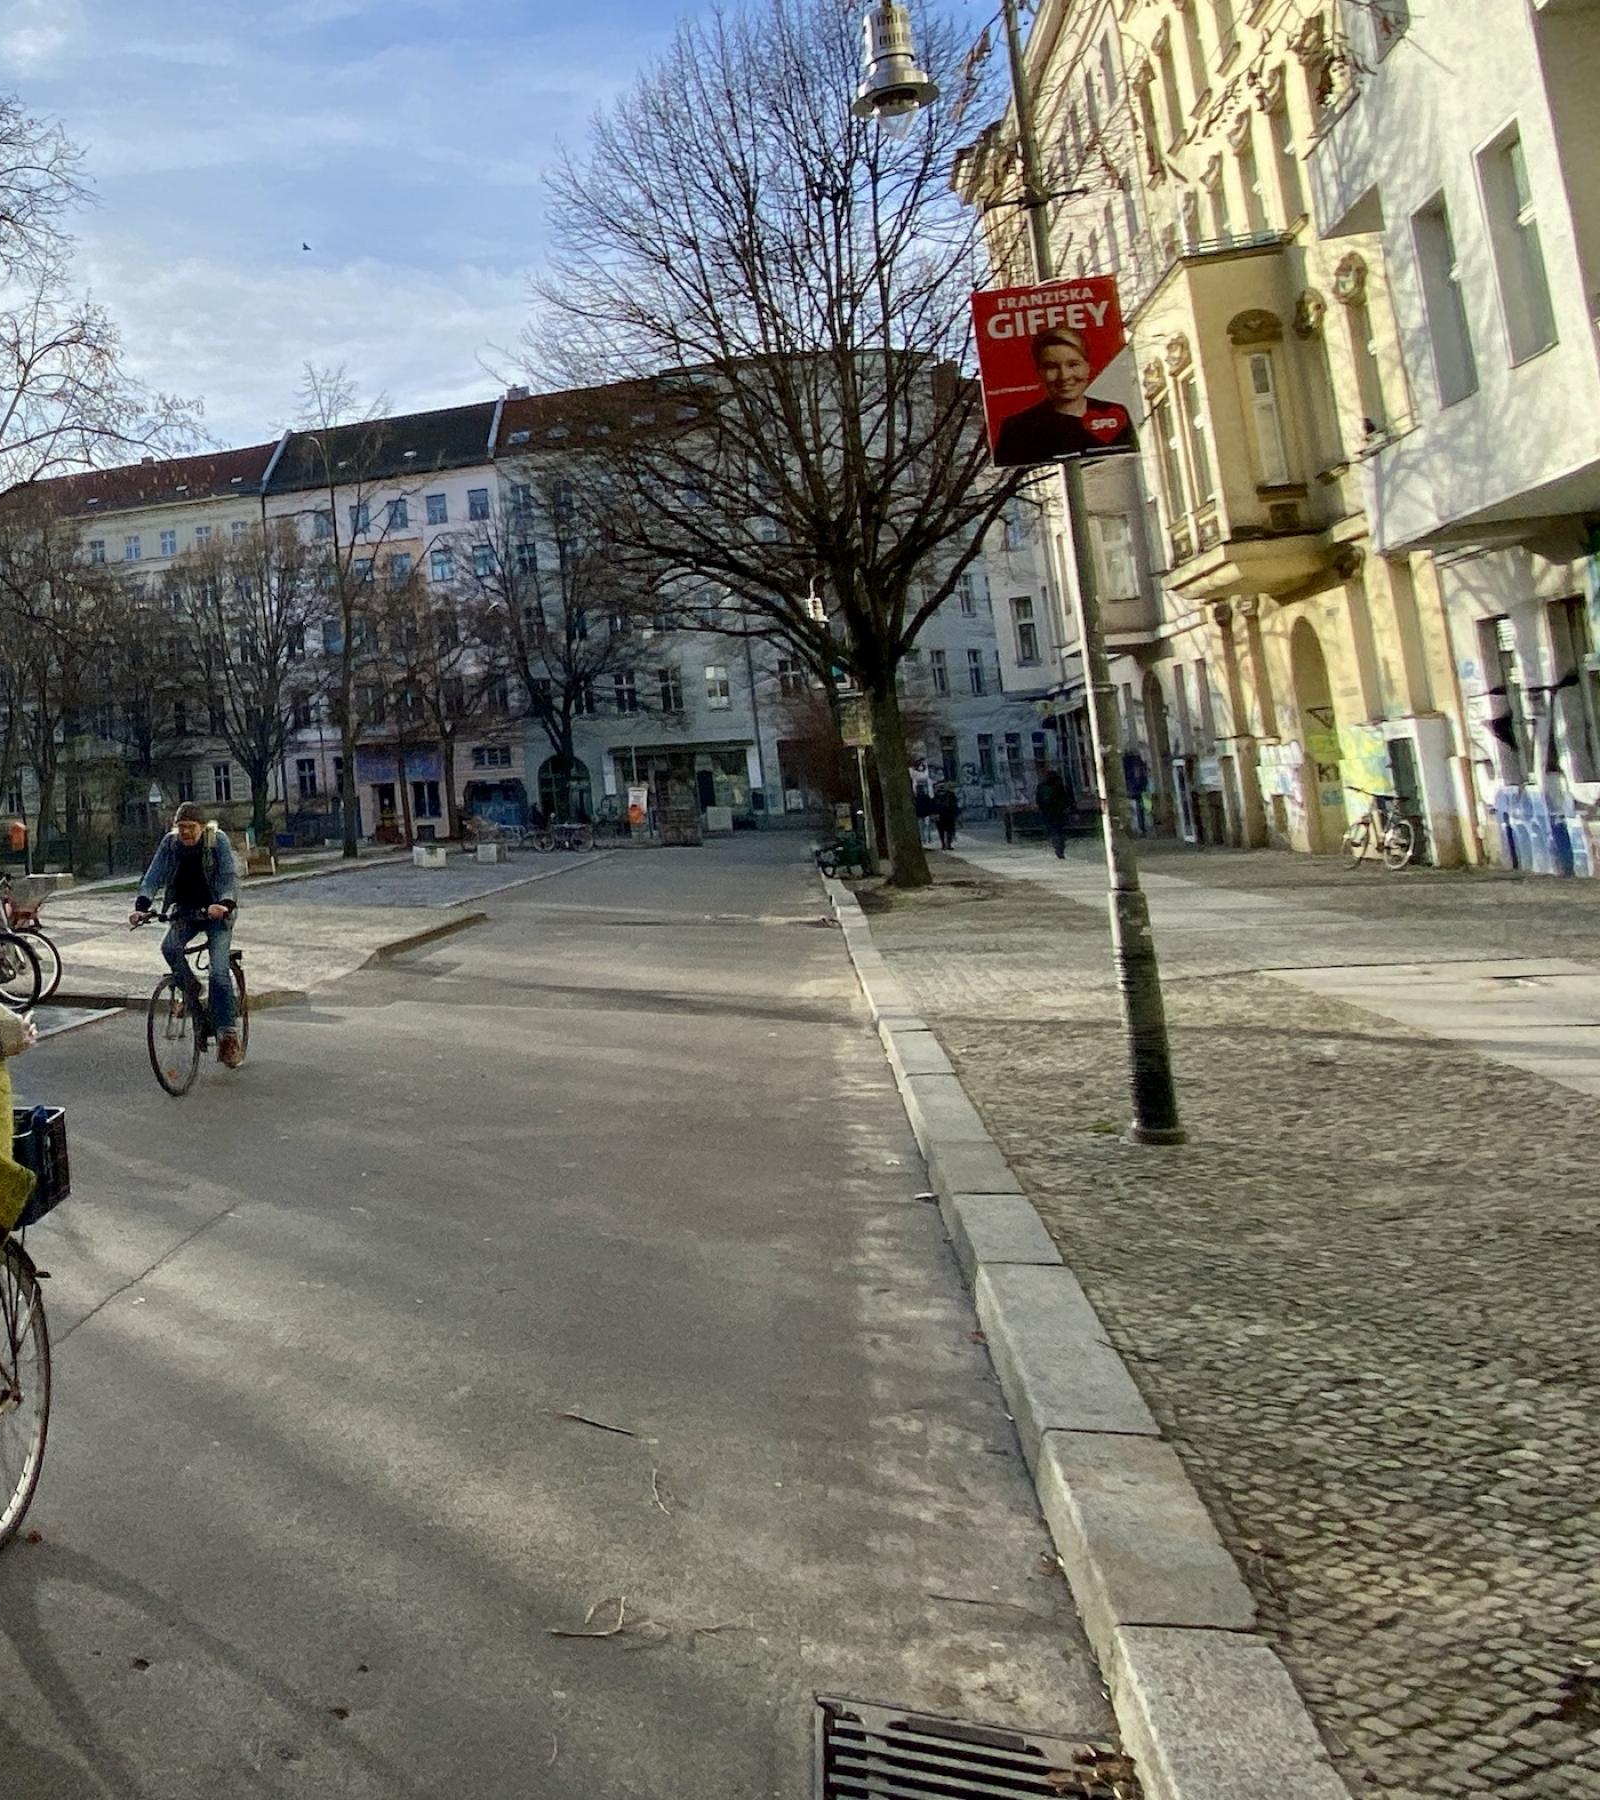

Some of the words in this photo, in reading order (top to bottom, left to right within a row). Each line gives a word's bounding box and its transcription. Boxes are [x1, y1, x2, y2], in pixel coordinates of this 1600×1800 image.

[998, 287, 1093, 309] FRANZISKA
[987, 301, 1109, 339] GIFFEY
[1091, 418, 1118, 430] SPD
